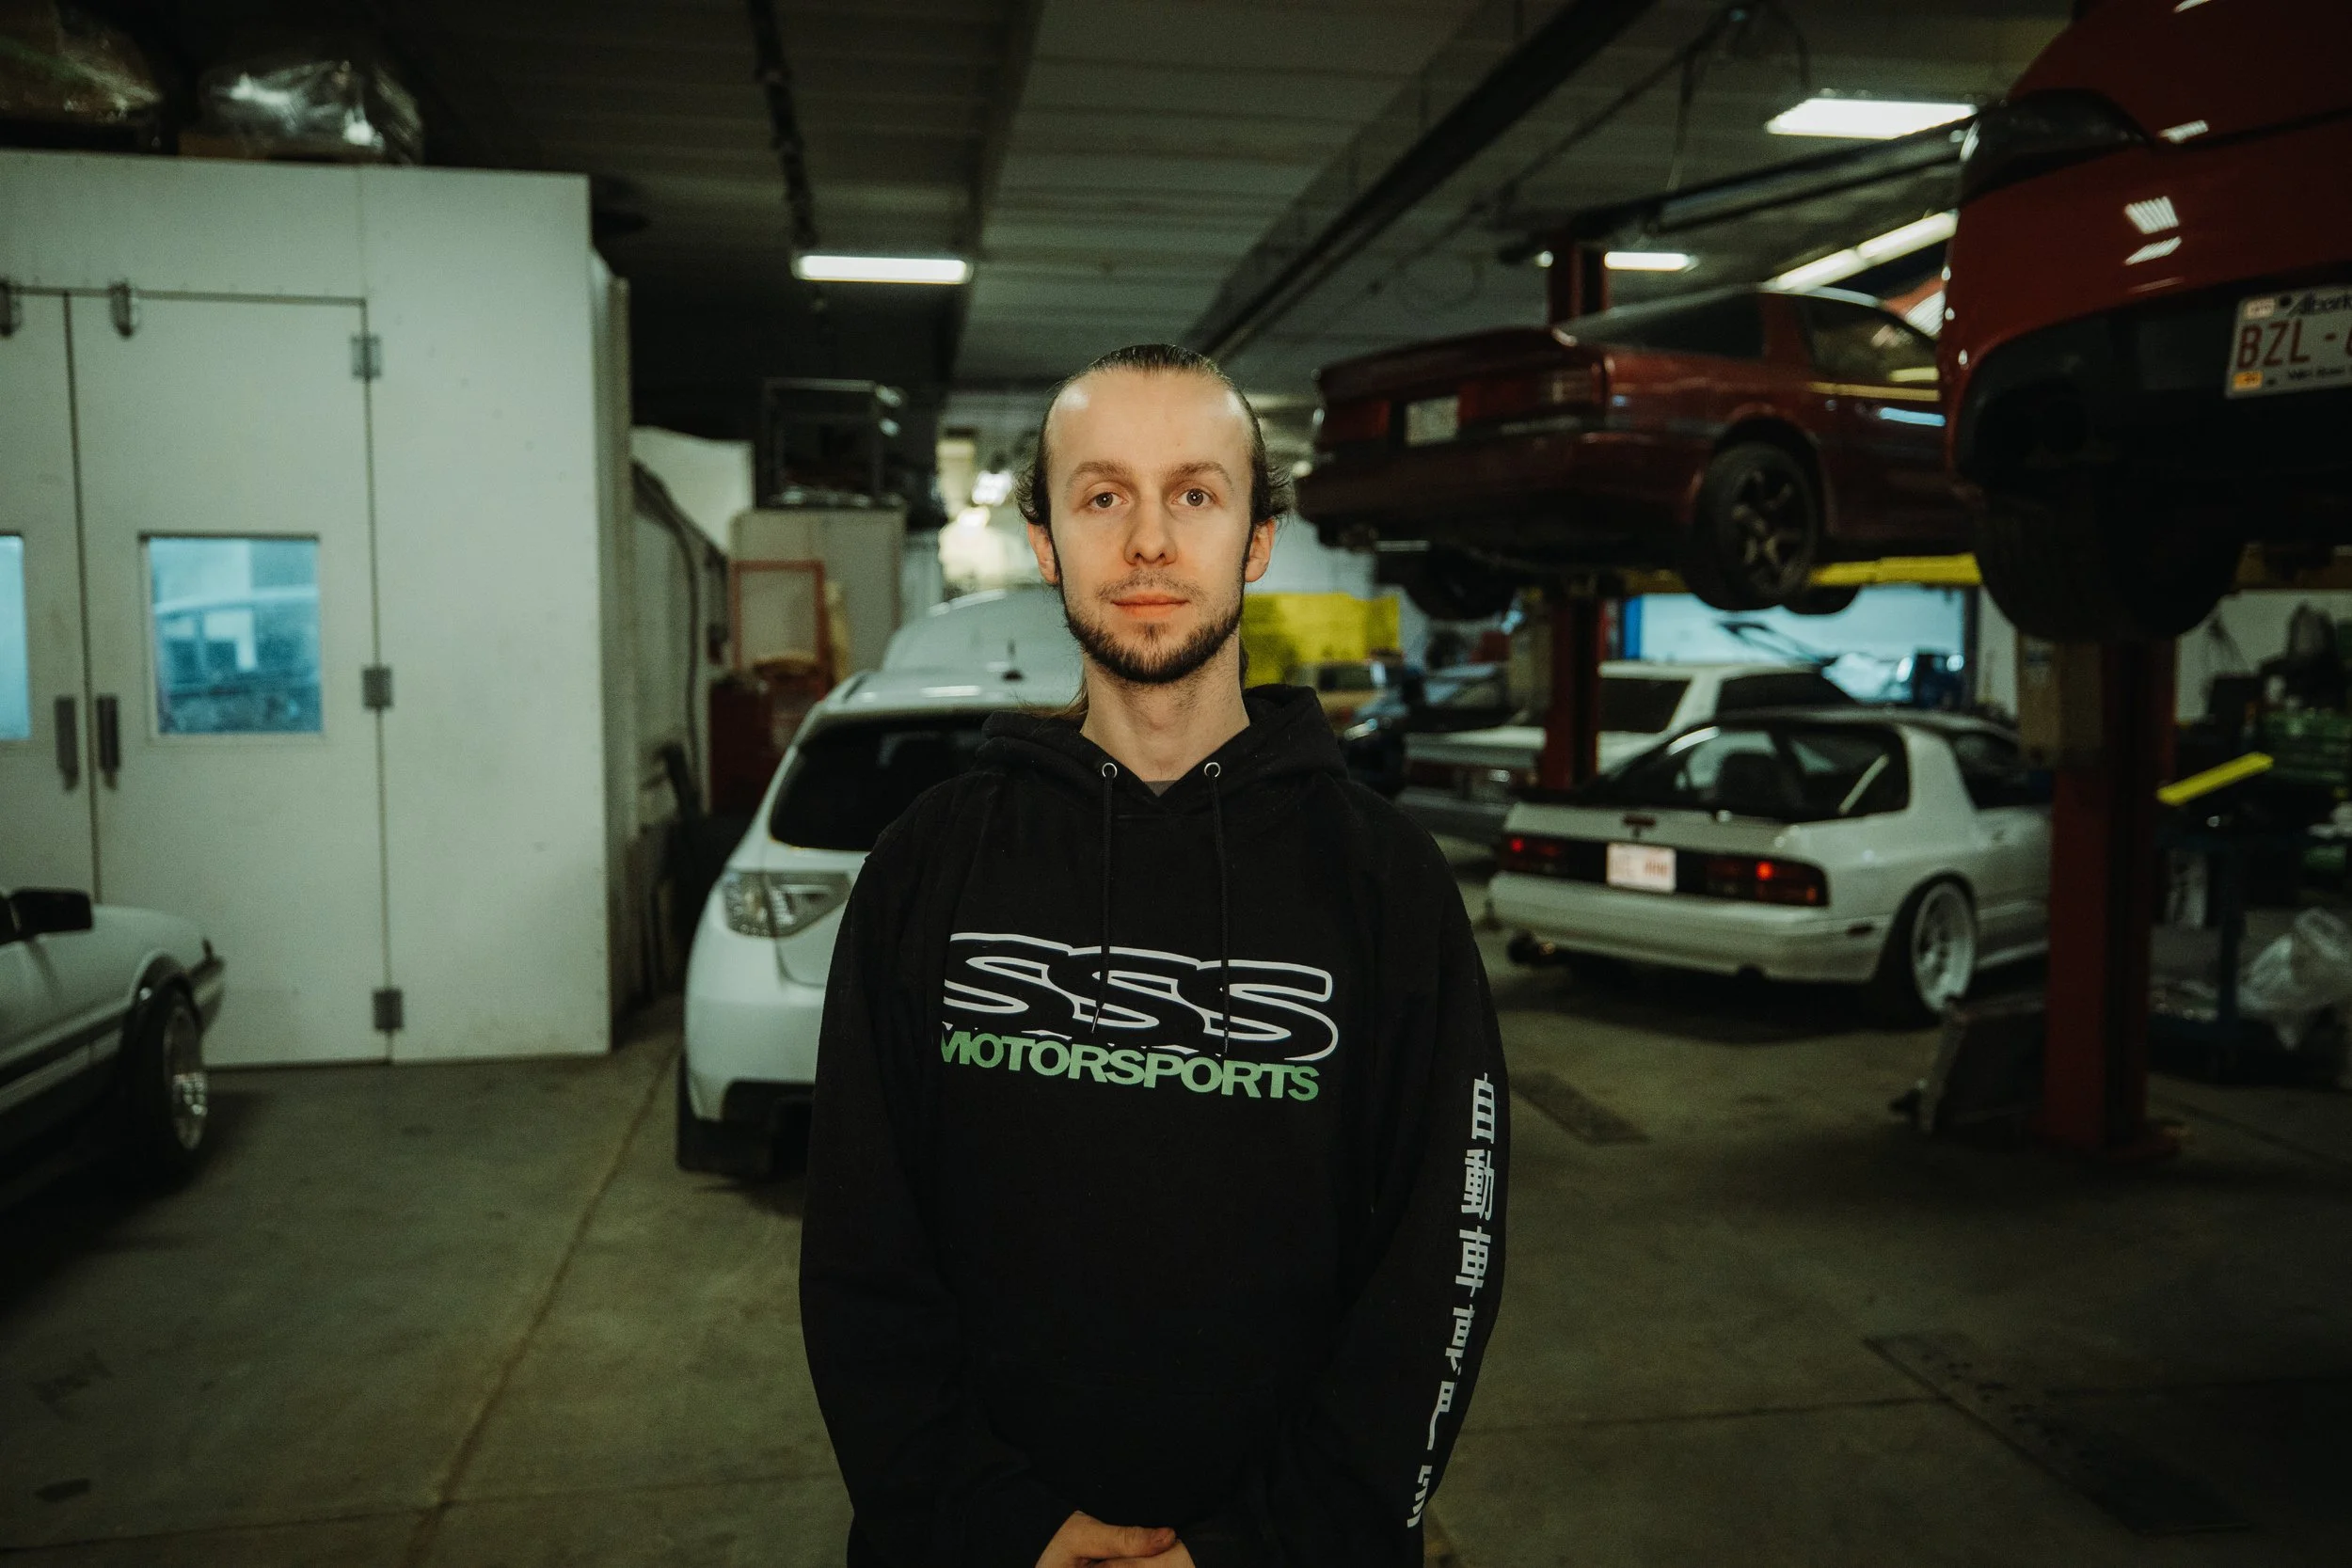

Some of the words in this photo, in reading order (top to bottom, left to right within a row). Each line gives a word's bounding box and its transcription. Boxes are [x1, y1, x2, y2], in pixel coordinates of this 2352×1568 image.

[2236, 318, 2352, 370] BZL-
[942, 932, 1338, 1061] SSS
[941, 1030, 1319, 1101] MOTORSPORTS
